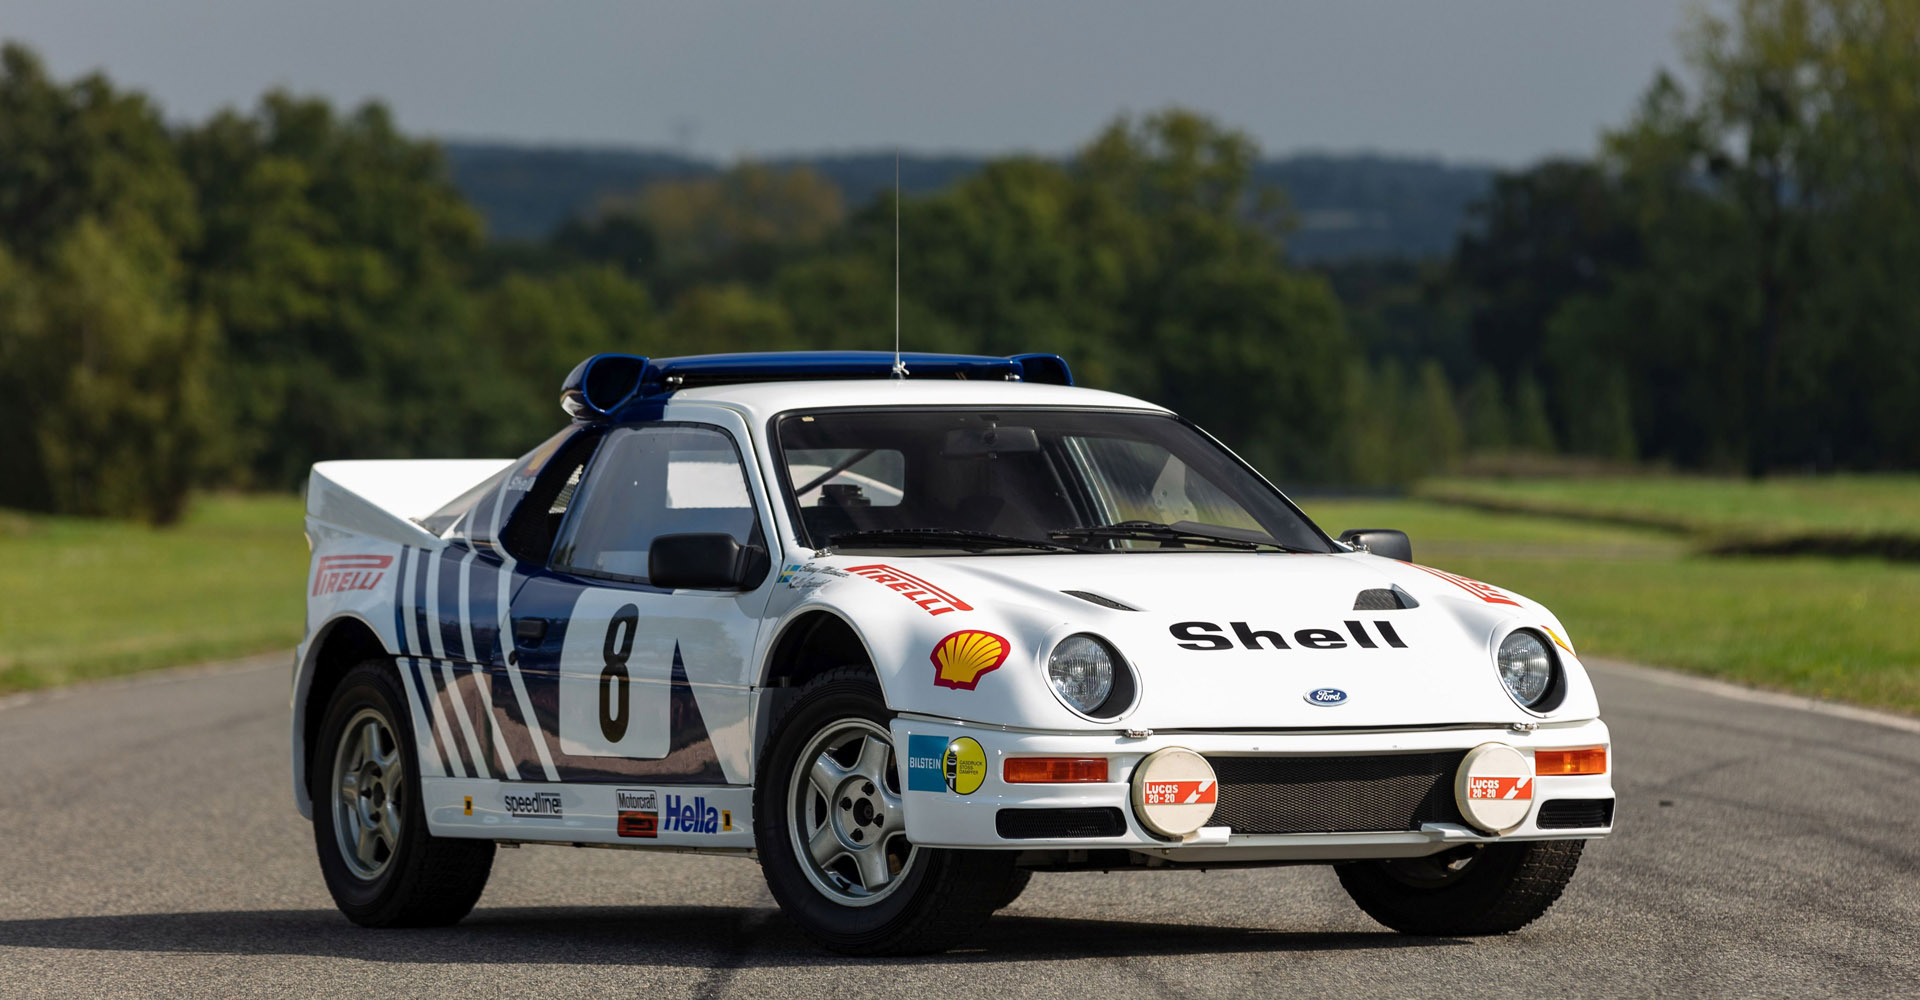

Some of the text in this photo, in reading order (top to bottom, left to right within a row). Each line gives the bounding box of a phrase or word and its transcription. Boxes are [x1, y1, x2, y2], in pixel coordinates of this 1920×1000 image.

[312, 554, 394, 597] PIRELLI
[843, 564, 974, 616] PIRELLI
[1169, 620, 1408, 650] Shell
[599, 603, 639, 743] 8
[1316, 689, 1341, 701] Ford
[909, 757, 941, 769] BILSTEIN
[1146, 782, 1179, 794] Lucas
[1471, 777, 1499, 789] Lucas
[618, 793, 656, 809] Motorcraft
[1148, 794, 1175, 804] 20-20
[1472, 788, 1497, 798] 20-20
[504, 792, 562, 819] speedline
[664, 794, 718, 834] Hella
